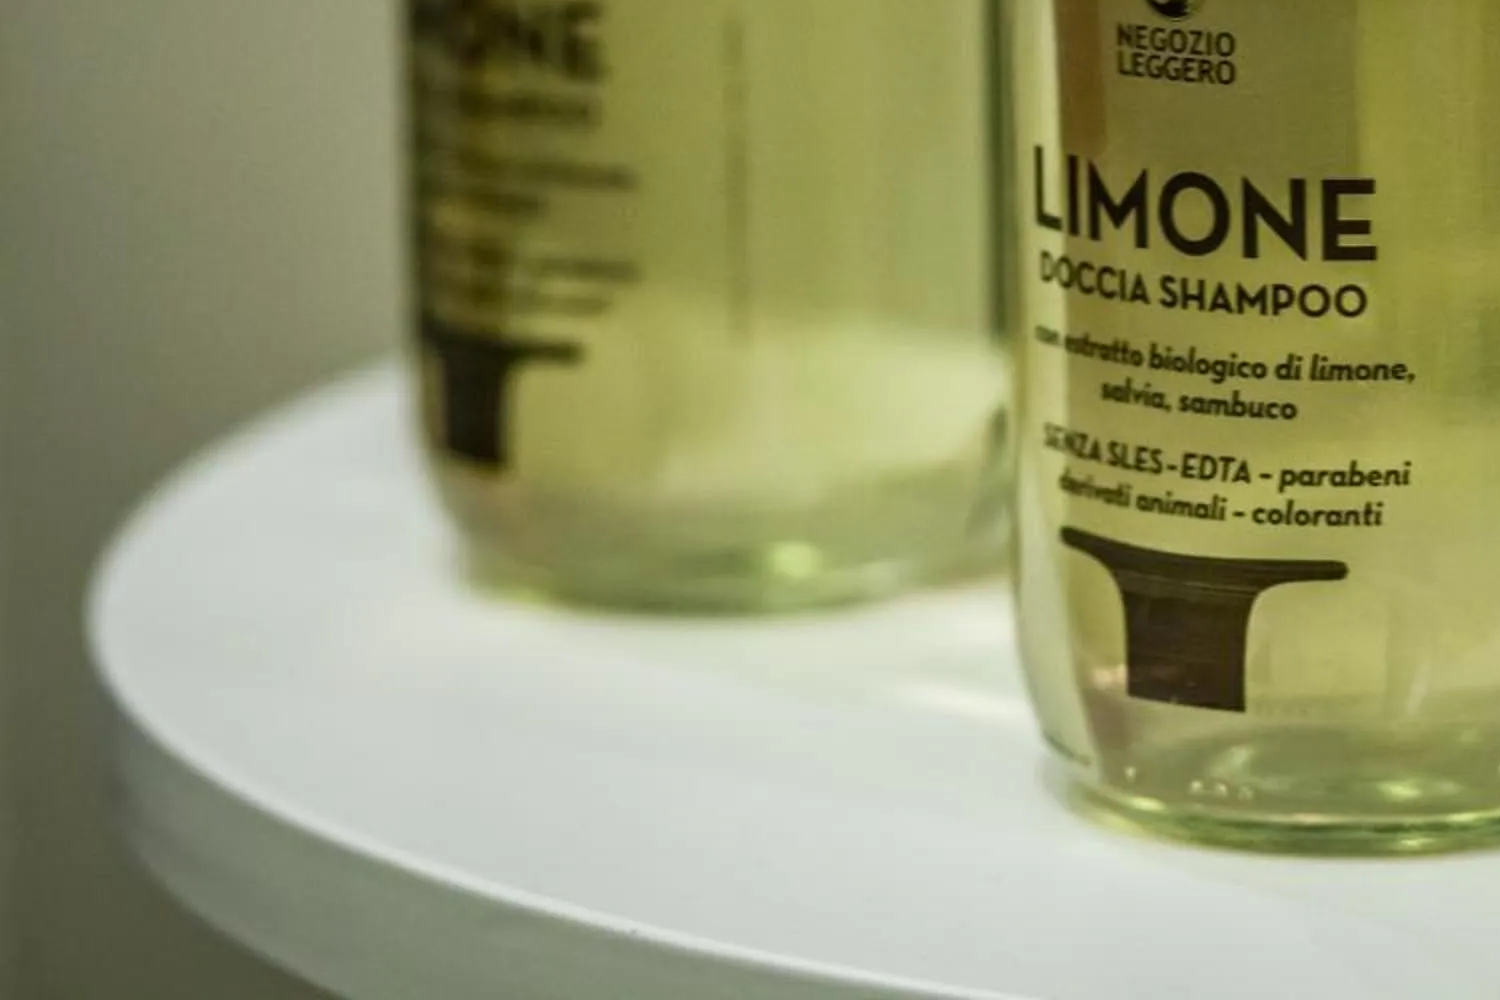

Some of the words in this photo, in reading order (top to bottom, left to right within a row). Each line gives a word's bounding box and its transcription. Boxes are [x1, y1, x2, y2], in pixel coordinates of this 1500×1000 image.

[1117, 23, 1235, 58] NEGOZIO
[1118, 50, 1235, 84] LEGGERO
[1034, 146, 1377, 261] LIMONE
[1040, 251, 1150, 305] DOCCIA
[1159, 276, 1367, 318] SHAMPOO
[1149, 342, 1268, 384] biologico
[1275, 353, 1302, 380] di
[1309, 353, 1415, 383] limone,
[1102, 377, 1171, 412] salvia,
[1179, 389, 1297, 419] sambuco
[1278, 460, 1412, 493] parabeni
[1136, 490, 1228, 521] animali
[1252, 500, 1383, 526] coloranti
